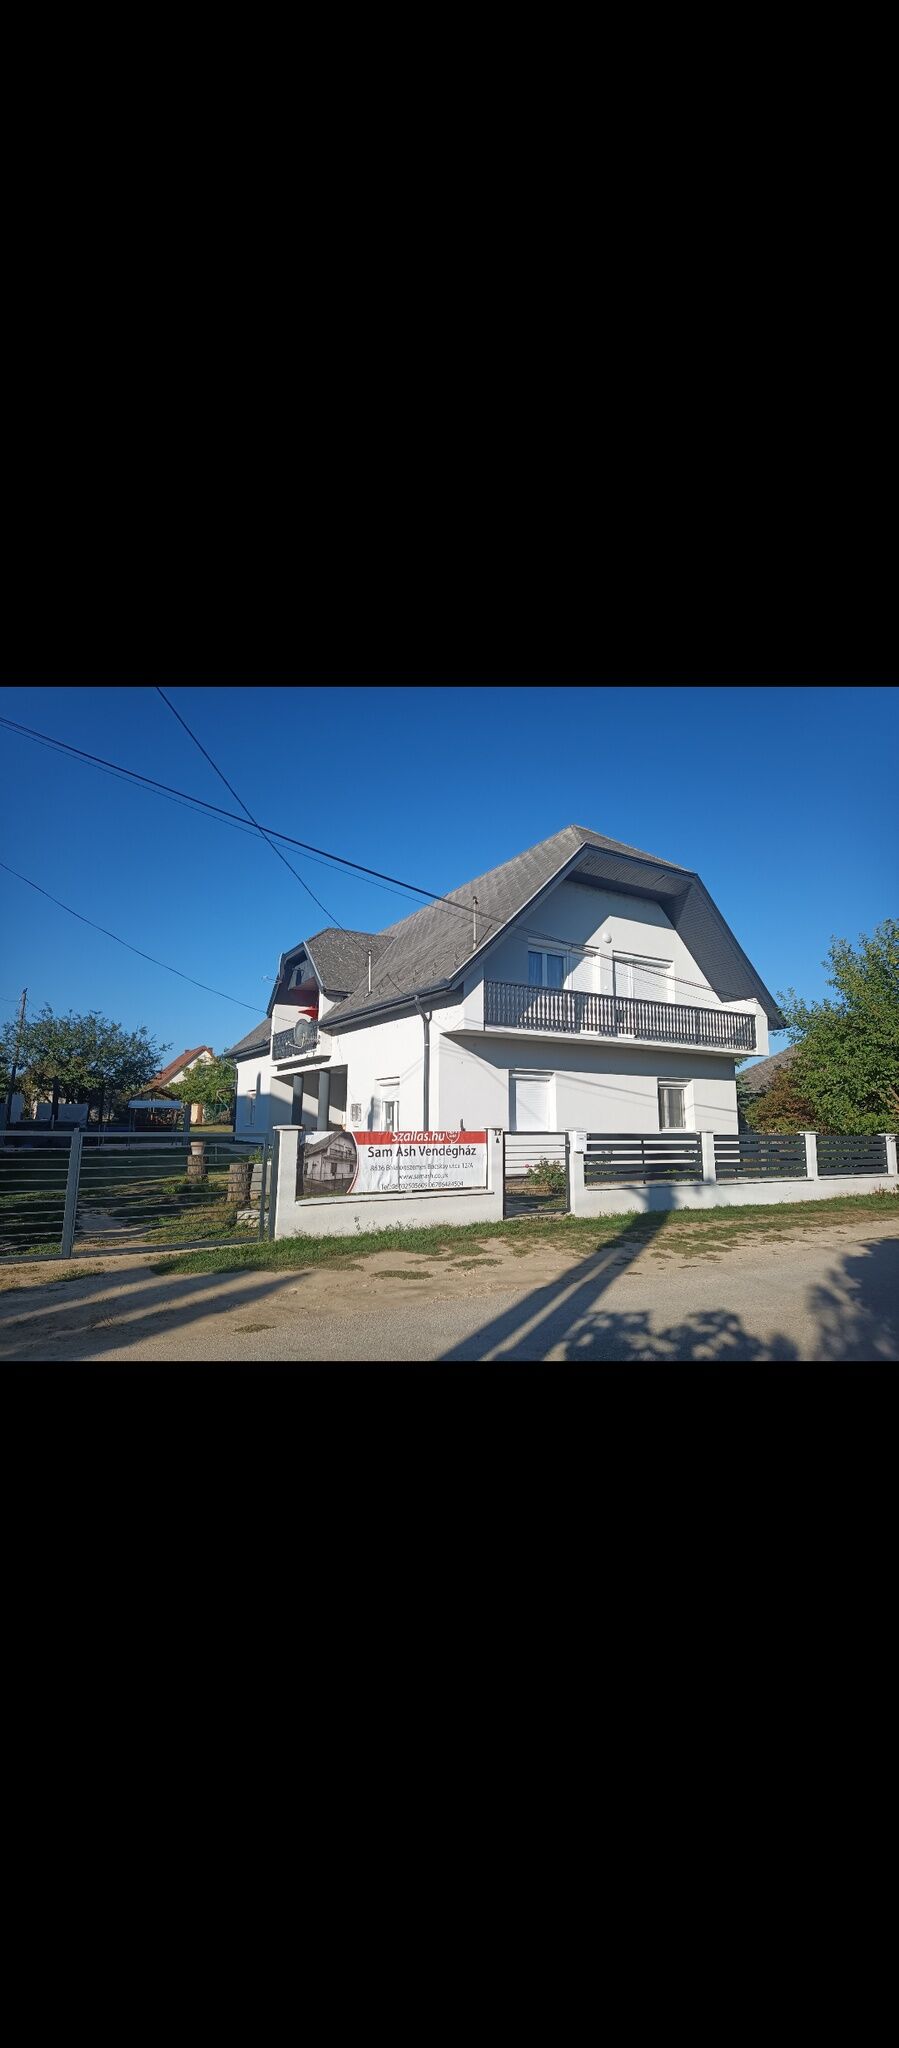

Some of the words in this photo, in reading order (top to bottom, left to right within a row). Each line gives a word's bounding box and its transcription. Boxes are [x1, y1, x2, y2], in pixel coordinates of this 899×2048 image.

[368, 1146, 393, 1158] Sam
[395, 1145, 416, 1157] Ash
[418, 1144, 477, 1159] Vendégház
